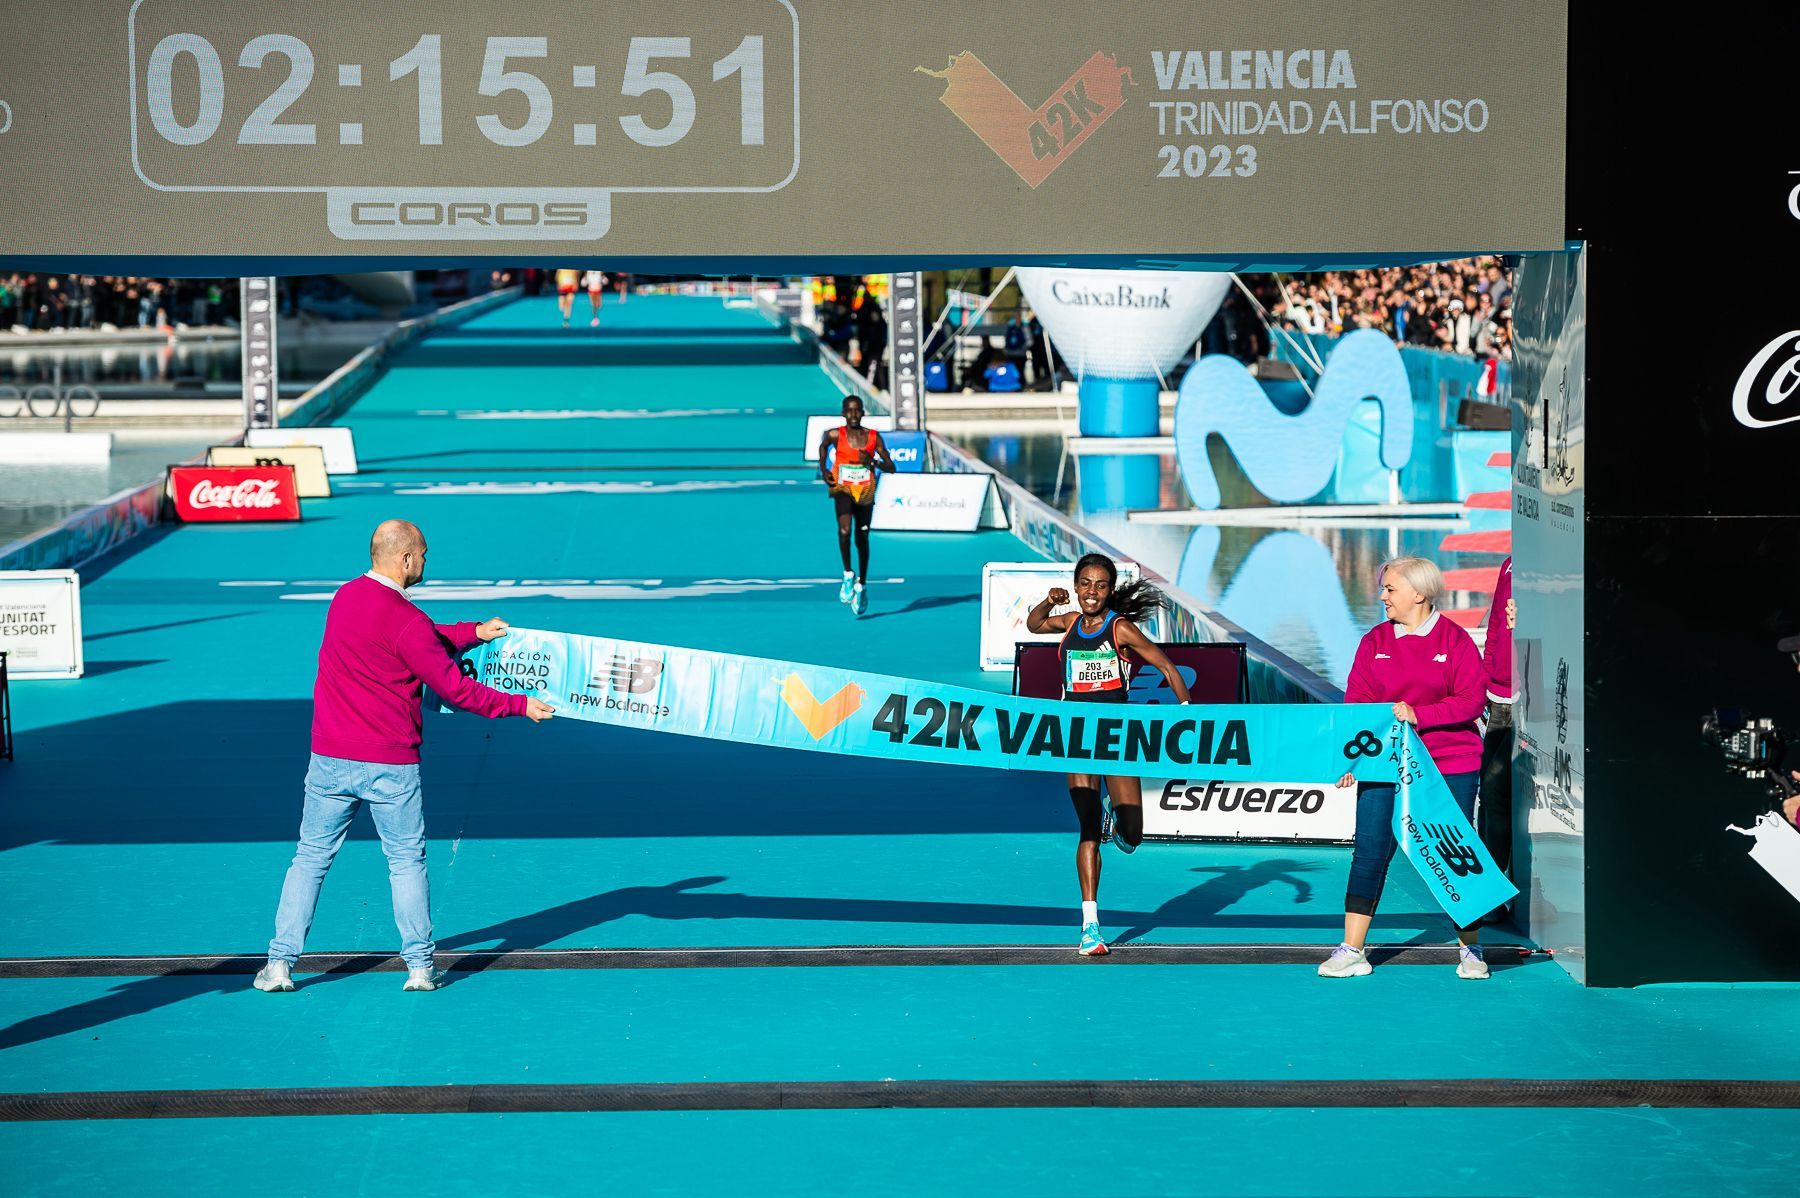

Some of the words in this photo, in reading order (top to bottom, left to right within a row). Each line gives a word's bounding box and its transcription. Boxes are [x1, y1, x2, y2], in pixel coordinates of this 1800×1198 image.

[1150, 49, 1357, 90] VALENCIA
[147, 31, 765, 148] 02:15:51
[1027, 78, 1107, 160] 42K
[1149, 100, 1312, 135] TRINIDAD
[1318, 99, 1490, 135] ALFONSO
[1156, 144, 1259, 178] 2023
[350, 201, 588, 227] COROS
[1053, 280, 1172, 309] CaixaBank
[189, 479, 281, 509] Coca-Cola
[487, 651, 552, 662] UNDACIÓN
[1085, 662, 1102, 670] 203
[1079, 670, 1113, 681] DEGEFA
[569, 691, 601, 707] new
[605, 694, 670, 717] balance
[872, 691, 985, 752] 42K
[993, 705, 1253, 766] VALENCIA
[1159, 778, 1325, 815] Esfuerzo
[1401, 814, 1424, 844] new
[1418, 844, 1461, 903] balance
